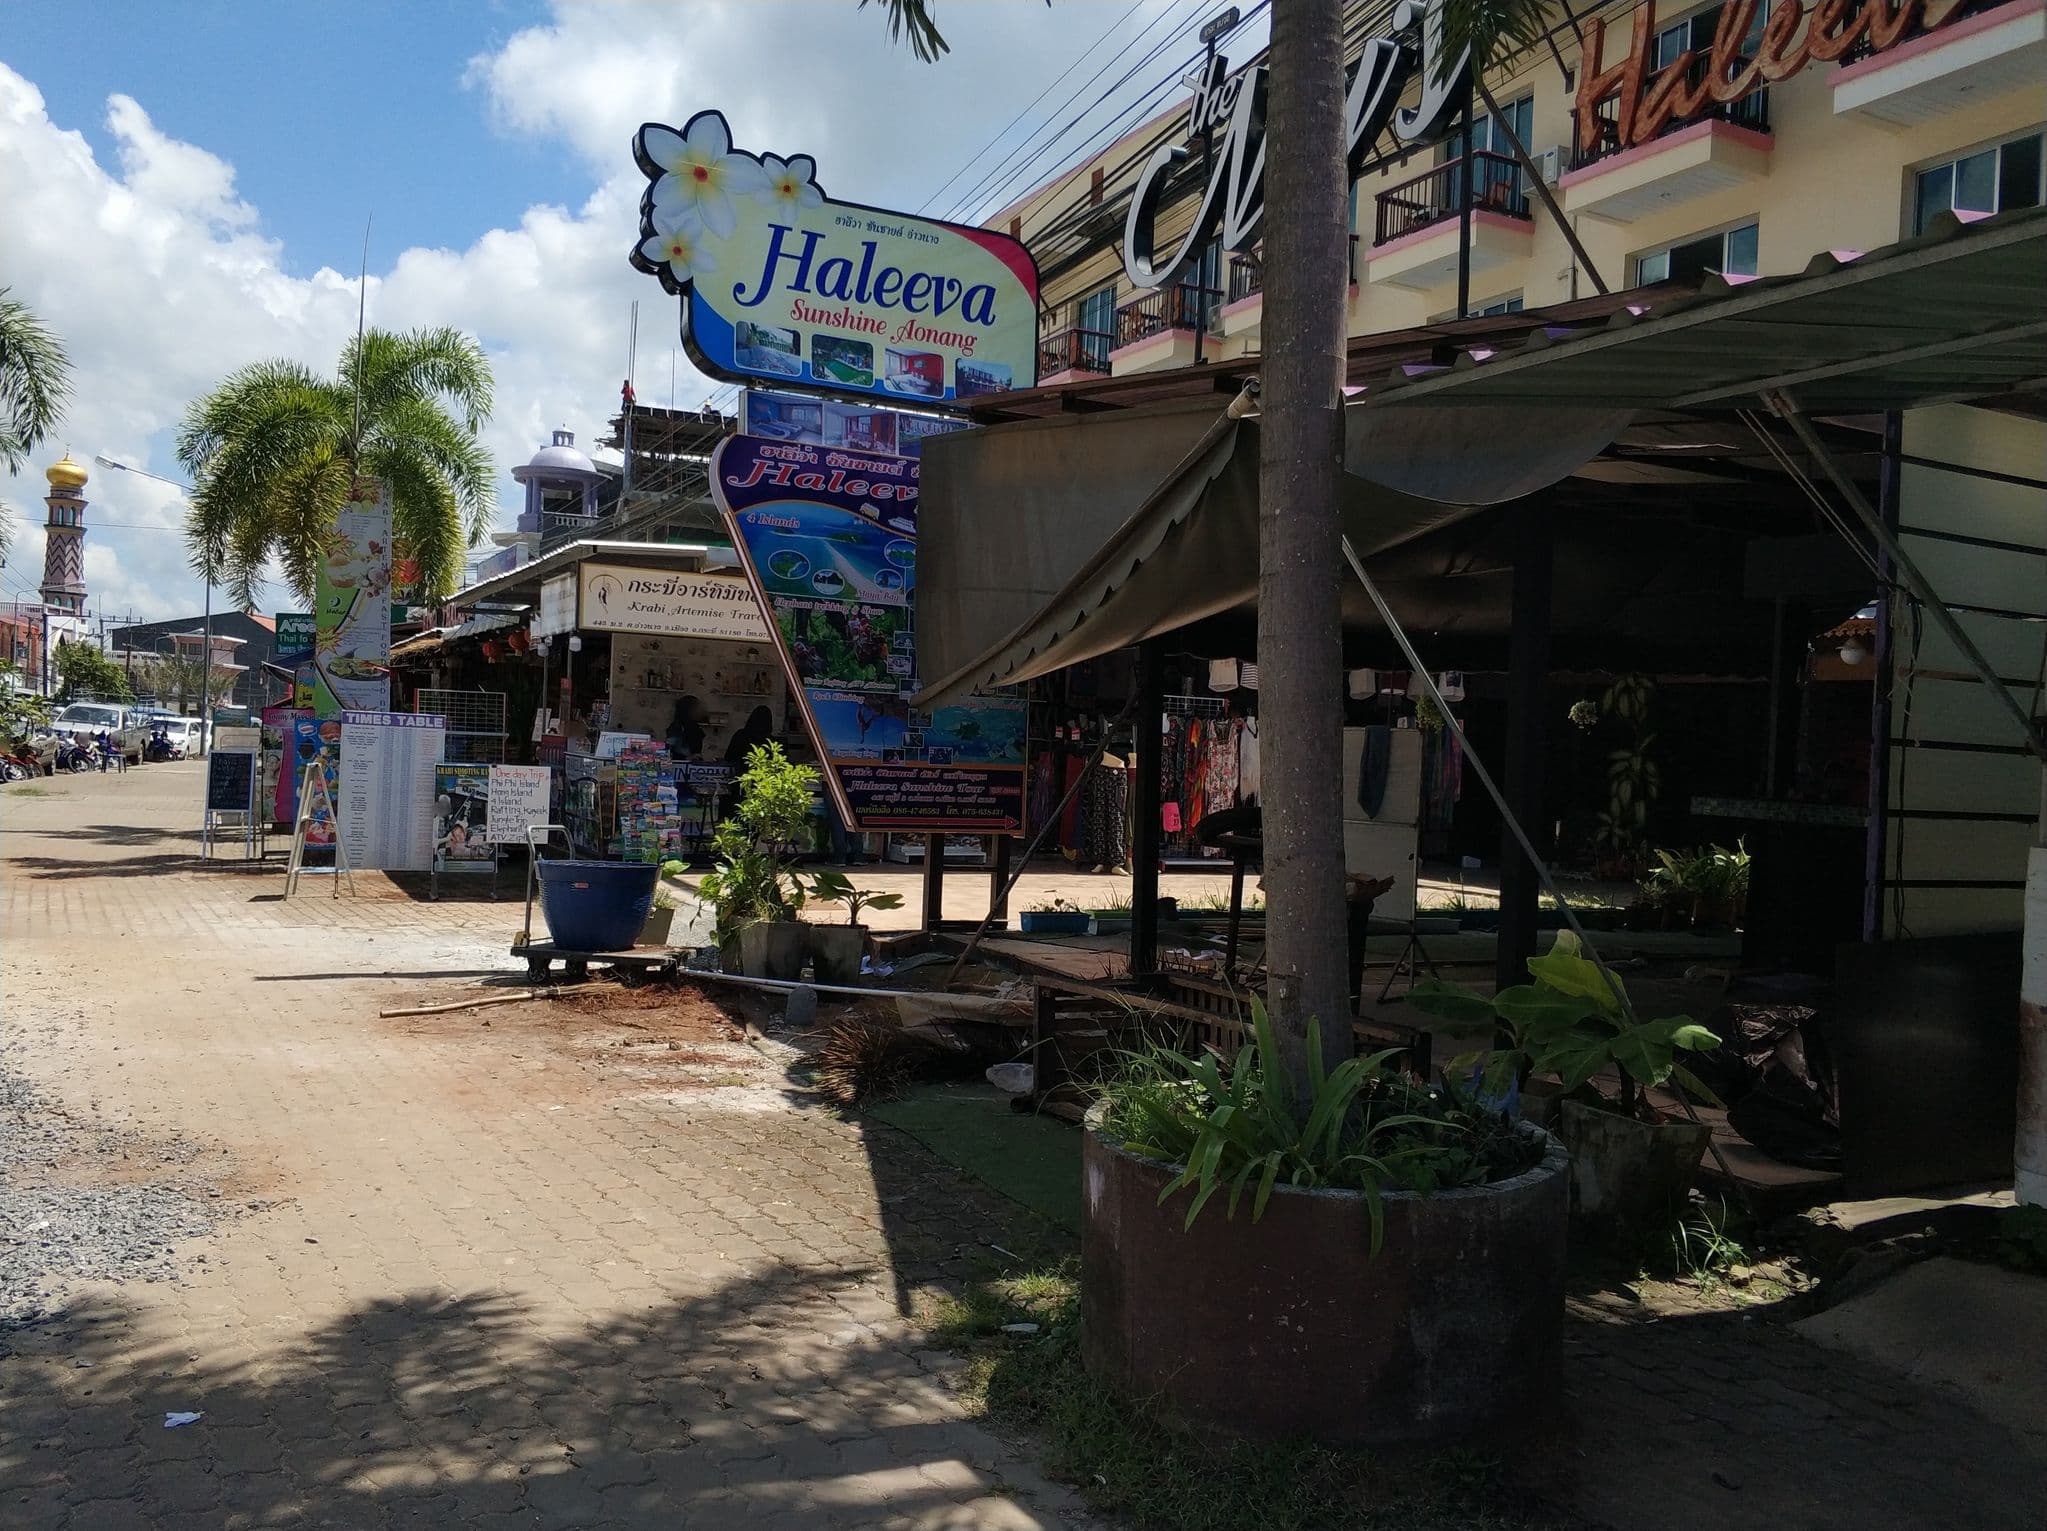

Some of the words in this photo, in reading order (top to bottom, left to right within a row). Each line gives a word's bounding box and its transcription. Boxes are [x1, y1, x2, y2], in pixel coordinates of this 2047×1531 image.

[1182, 54, 1239, 139] the
[733, 223, 996, 326] Haleeva
[791, 299, 887, 336] Sunshine
[891, 320, 978, 357] Aonang
[746, 512, 756, 524] 4
[757, 512, 801, 529] Islands
[627, 601, 665, 615] Krabi
[667, 604, 725, 618] Artemise
[773, 597, 813, 609] Elephant
[346, 712, 391, 726] TIMES
[397, 715, 444, 728] TABLE
[511, 768, 528, 779] day
[519, 779, 540, 788] Island
[510, 788, 533, 797] Island
[498, 797, 522, 806] Island
